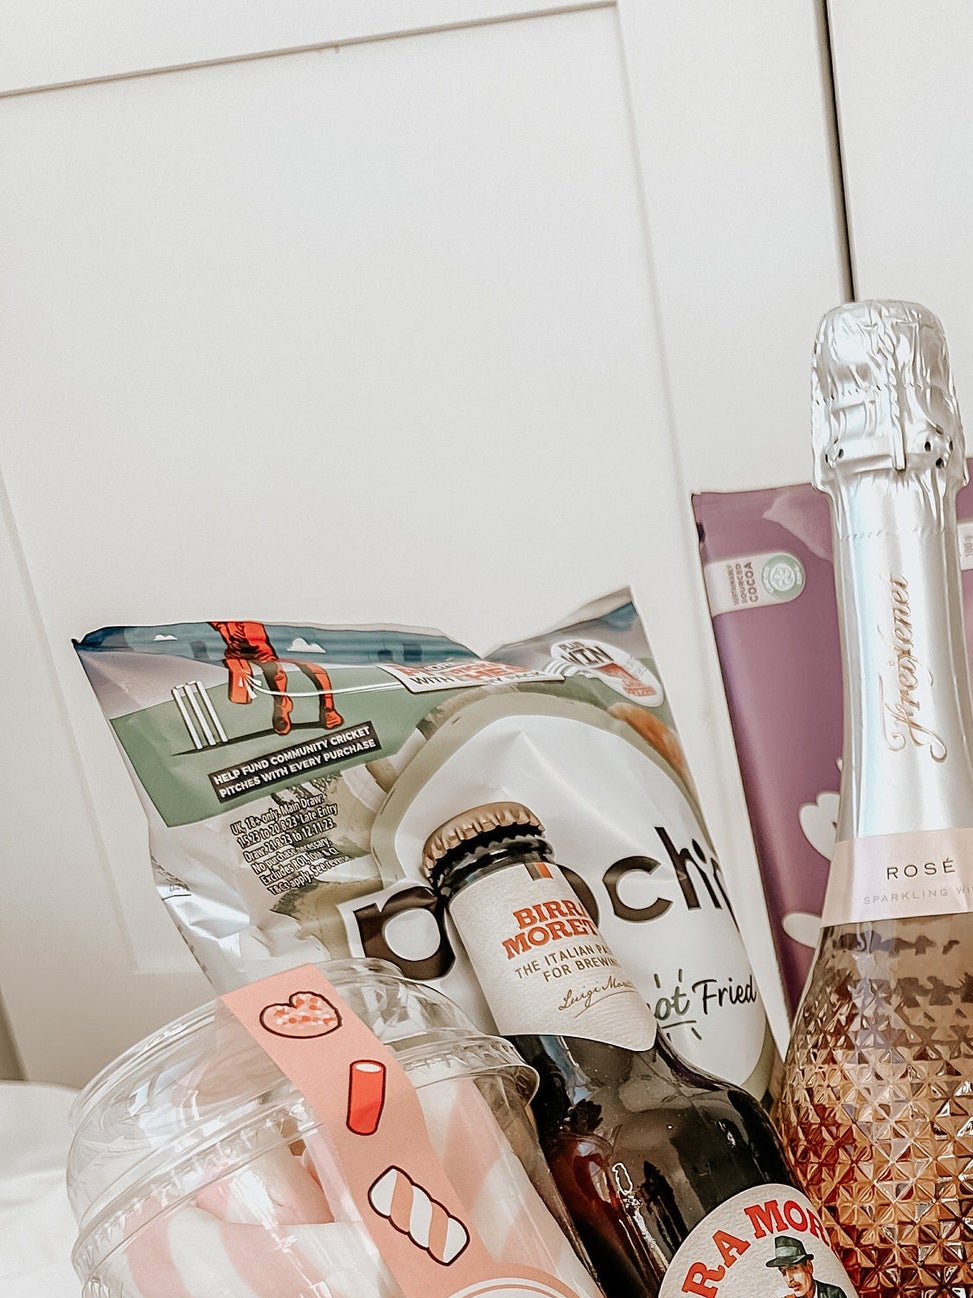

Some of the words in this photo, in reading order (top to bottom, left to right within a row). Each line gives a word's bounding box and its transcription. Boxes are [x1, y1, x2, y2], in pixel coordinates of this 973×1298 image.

[735, 563, 748, 604] SOURCED
[744, 561, 759, 603] COCOA
[213, 770, 241, 785] HELP
[241, 760, 269, 775] FUND
[270, 740, 328, 765] COMMUNITY
[331, 726, 370, 744] CRICKET
[219, 775, 261, 798] PITCHES
[260, 767, 288, 783] WITH
[291, 755, 322, 773] EVERY
[324, 738, 376, 762] PURCHASE
[245, 816, 261, 829] 18+
[280, 801, 300, 815] Main
[300, 795, 325, 809] Draw:
[260, 828, 270, 840] to
[298, 809, 317, 823] Late
[317, 803, 338, 818] Entry
[243, 846, 268, 863] Draw:
[291, 831, 302, 843] to
[251, 862, 265, 875] No
[259, 863, 292, 886] Excludes
[289, 869, 314, 888] apply.
[310, 864, 327, 877] See
[886, 858, 955, 880] ROSÉ
[864, 888, 948, 905] SPARKLING
[502, 919, 598, 960] MORET
[515, 960, 541, 979] THE
[544, 944, 594, 966] ITALIAN
[543, 965, 572, 982] FOR
[574, 956, 619, 972] BREWIN
[647, 986, 690, 1021] ot
[692, 974, 757, 1015] Fried
